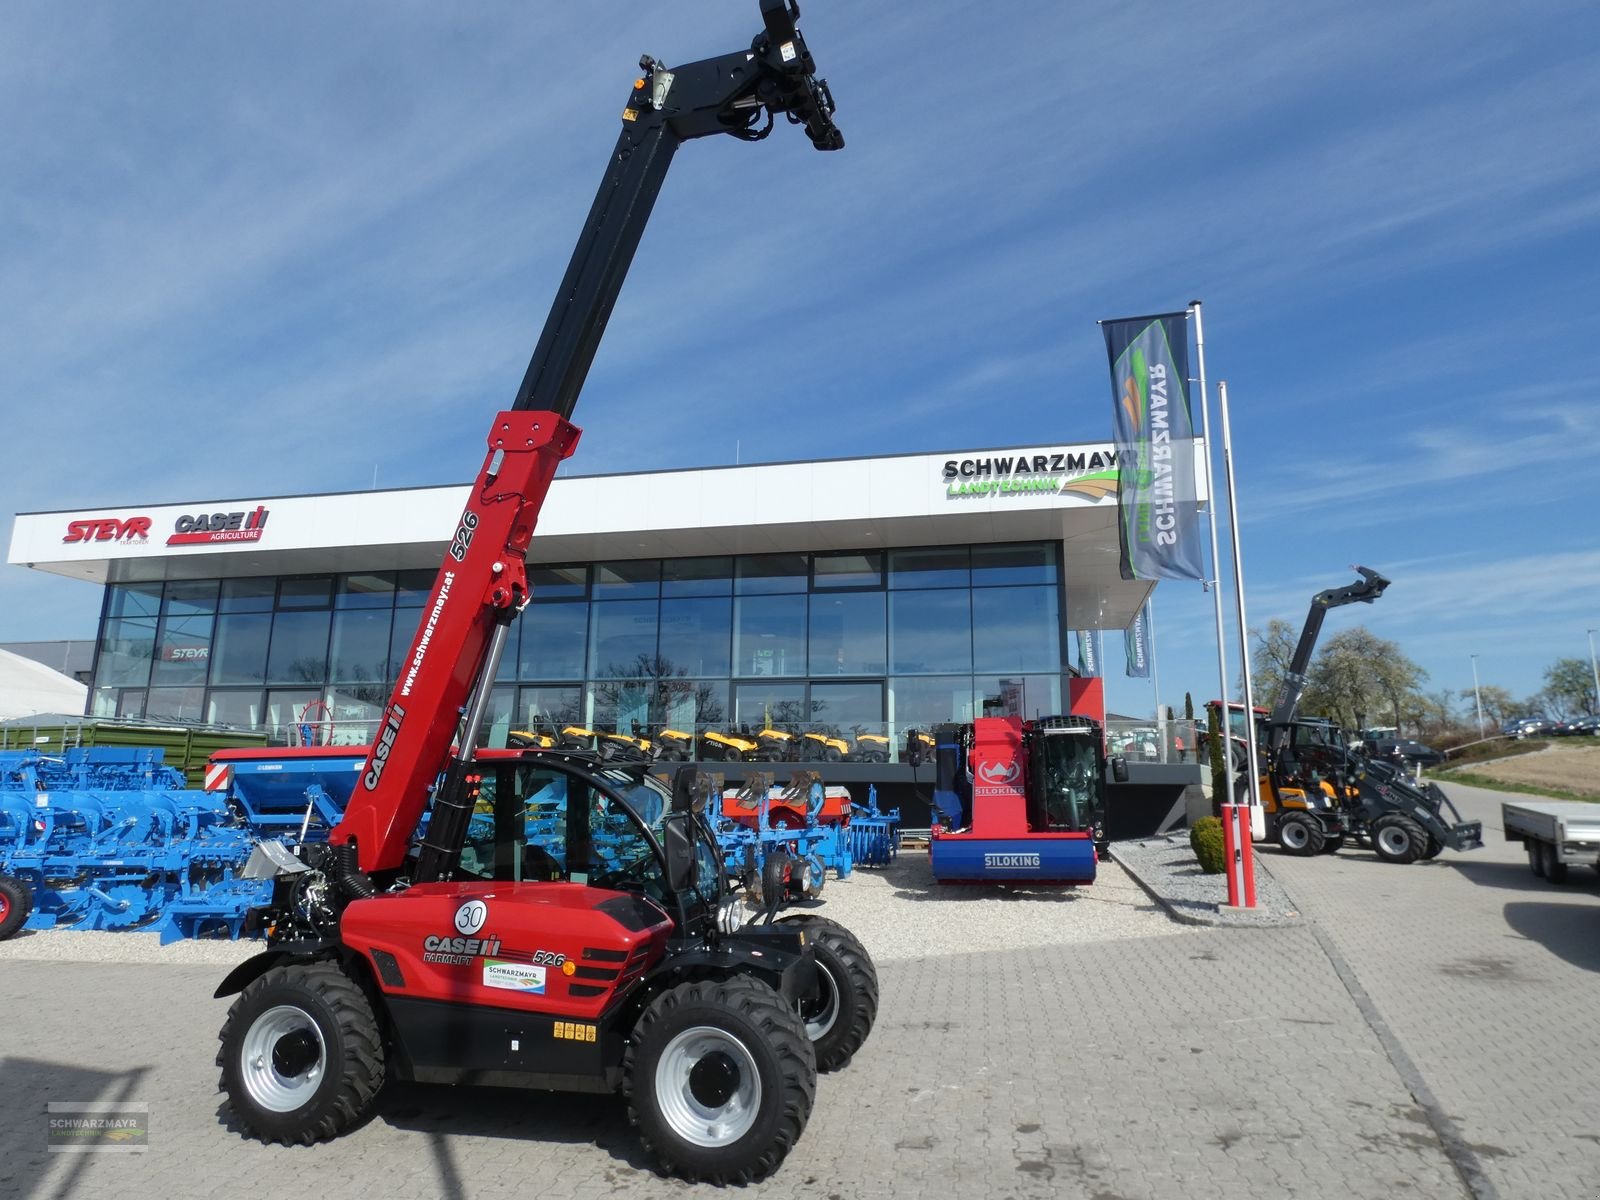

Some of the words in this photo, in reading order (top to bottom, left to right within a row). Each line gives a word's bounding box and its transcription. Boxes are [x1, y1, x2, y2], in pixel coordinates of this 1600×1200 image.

[944, 450, 1121, 477] SCHWARZMAY
[949, 478, 1060, 496] LANDTECHNIK
[63, 516, 152, 543] STEYR
[174, 512, 244, 533] CASE
[210, 530, 259, 541] AGRICULTURE
[450, 510, 479, 562] 526
[400, 571, 455, 697] www.schwarzmayr.at
[171, 647, 209, 659] STEYR
[364, 725, 397, 791] CASE
[975, 787, 1025, 796] SILOKING
[984, 856, 1040, 867] SILOKING
[458, 906, 483, 928] 30
[424, 935, 480, 956] CASE
[423, 952, 473, 966] FARMLIFT
[533, 950, 565, 967] 526
[489, 966, 537, 979] SCHWARZMAYR
